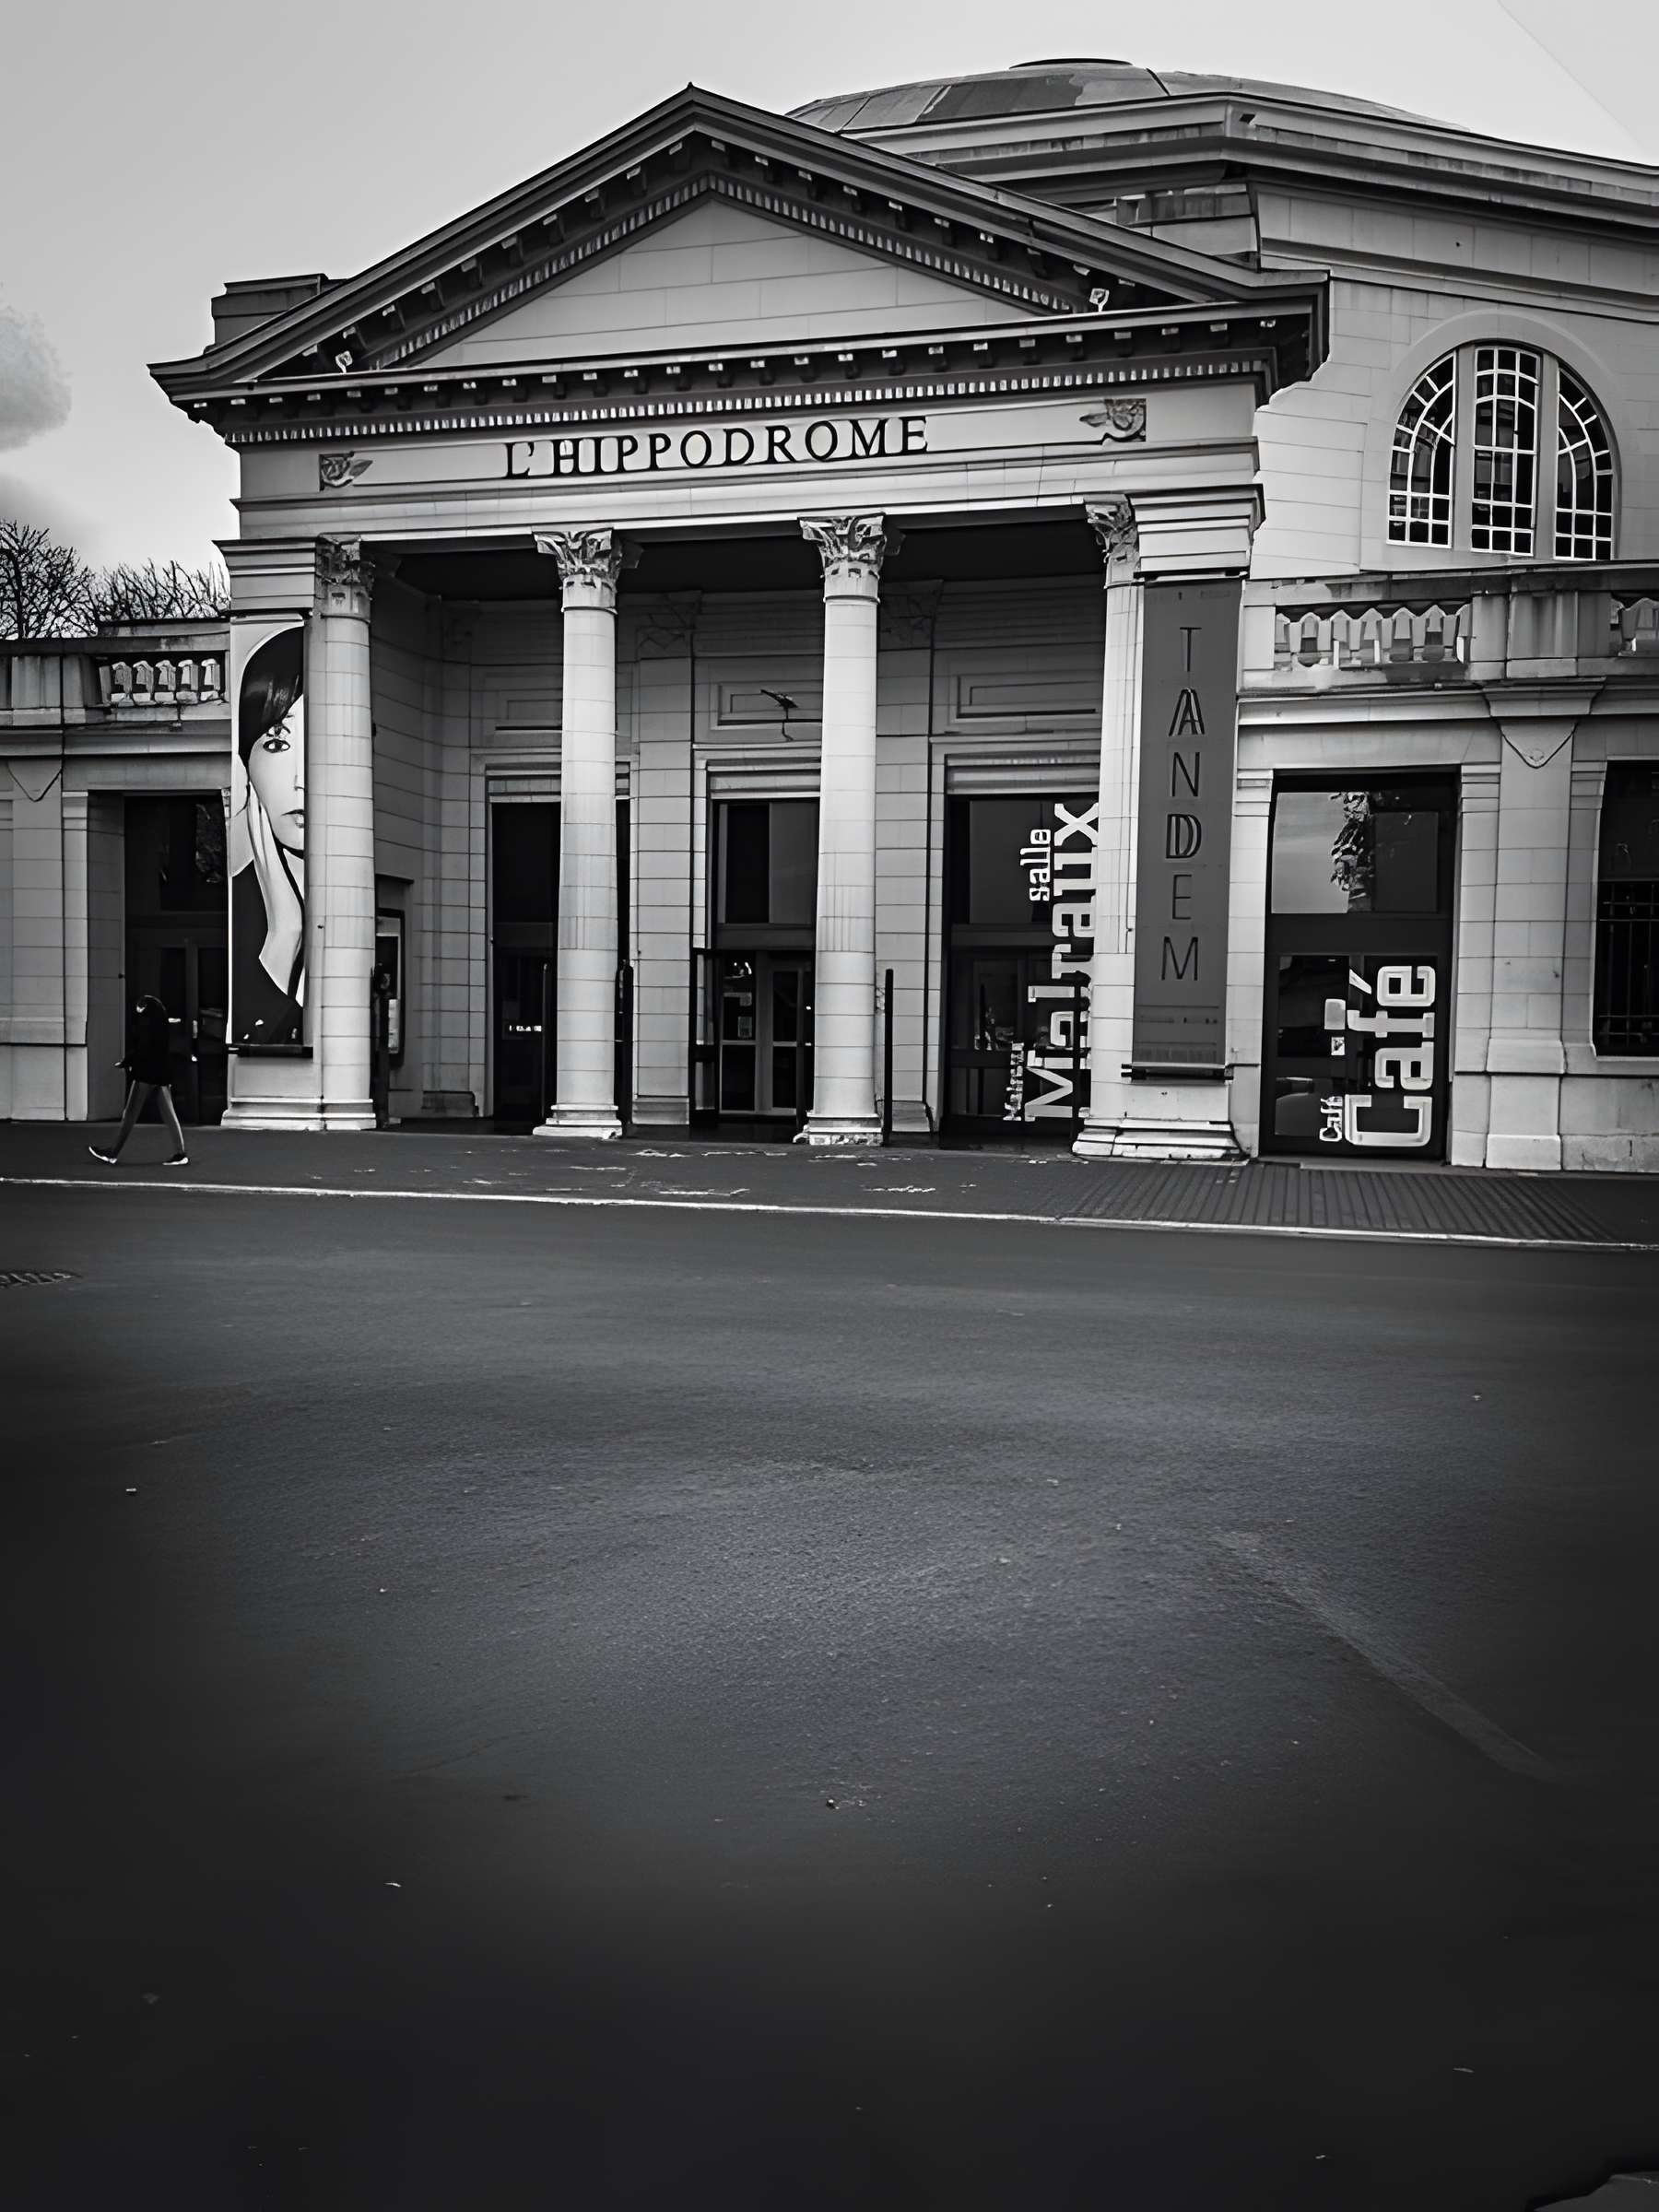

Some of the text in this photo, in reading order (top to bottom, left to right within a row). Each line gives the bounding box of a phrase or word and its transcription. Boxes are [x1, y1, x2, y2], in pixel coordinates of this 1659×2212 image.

[502, 415, 927, 479] L'HIPPODROME
[1020, 829, 1052, 901] salle
[1160, 627, 1205, 981] TANDEM
[1023, 802, 1099, 1122] Malraux
[1344, 965, 1436, 1147] Café
